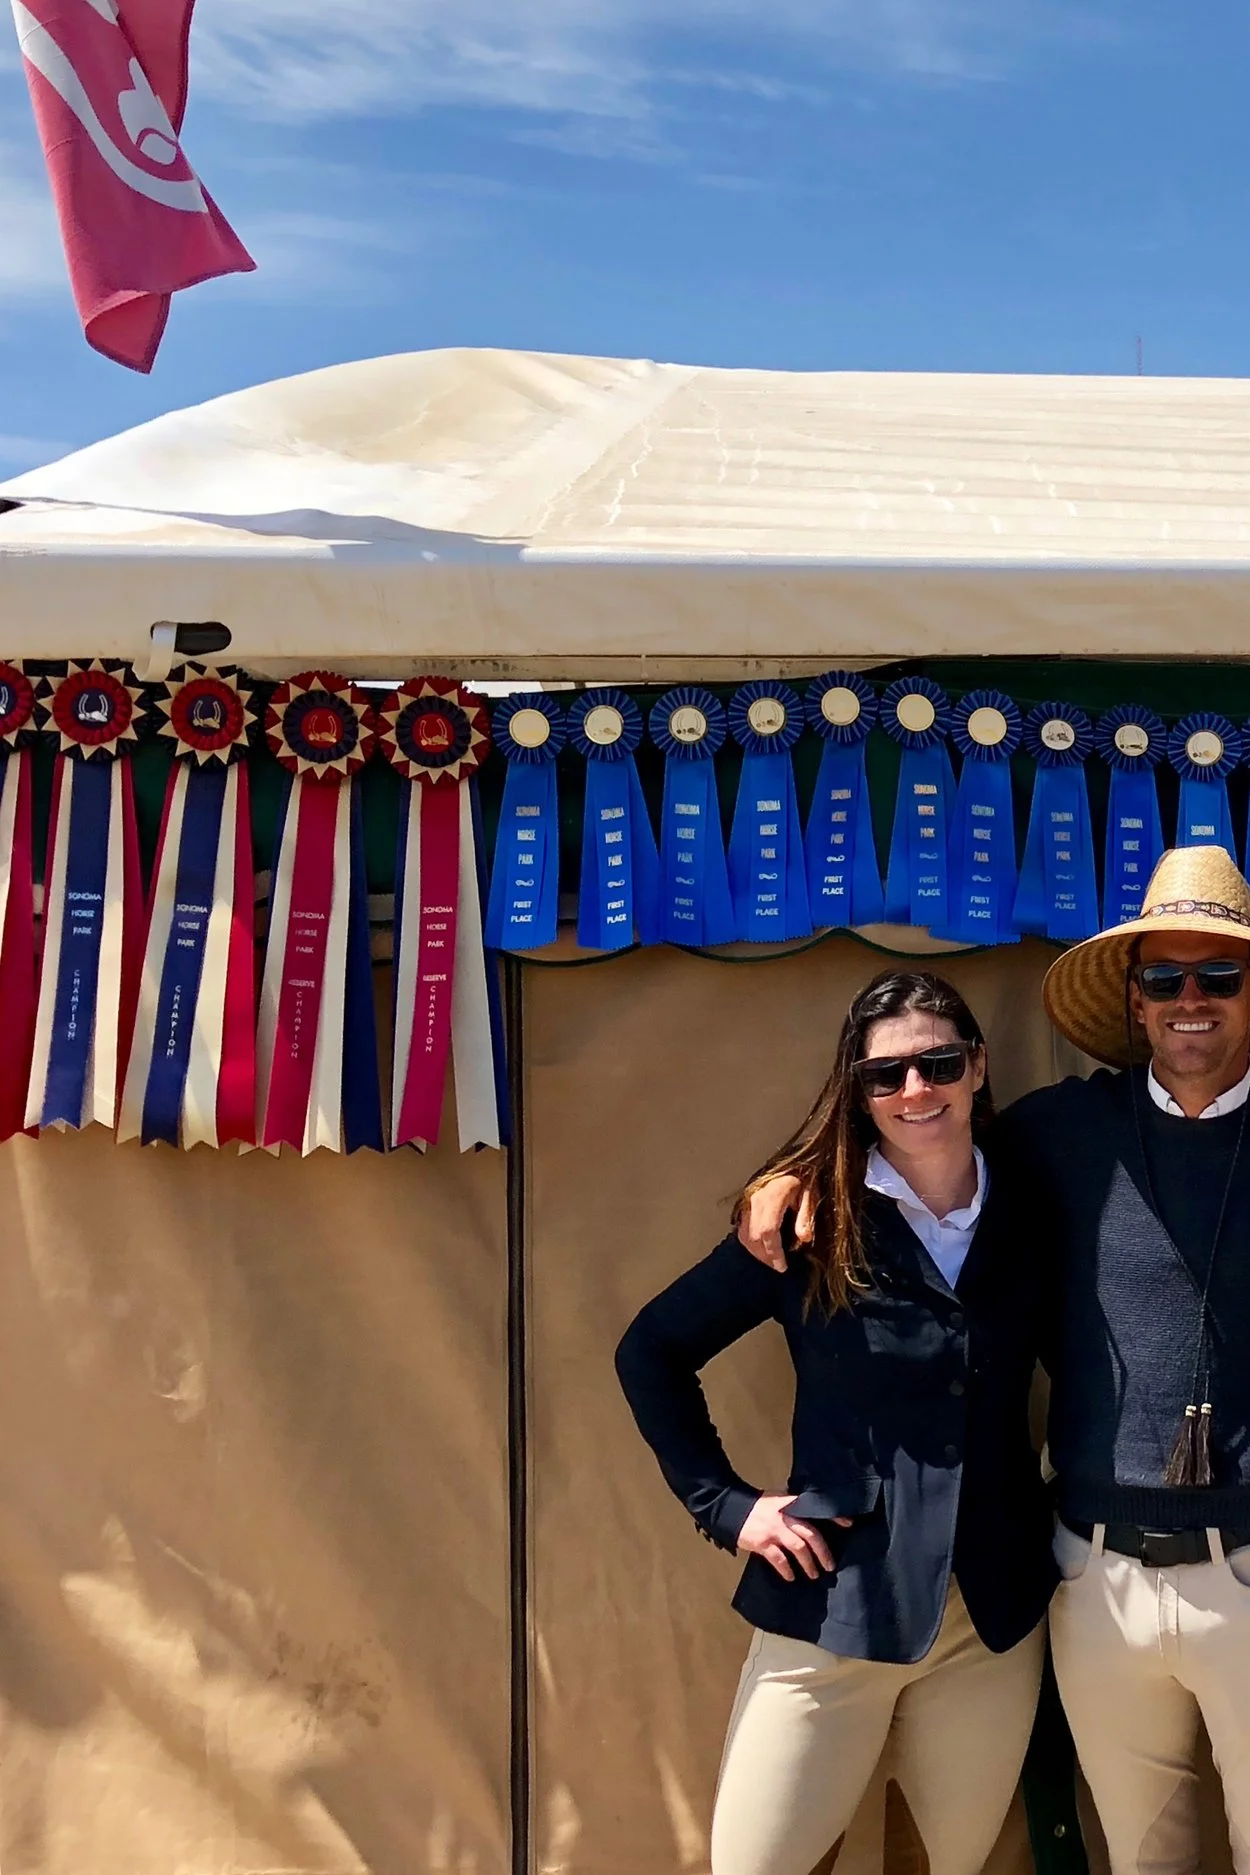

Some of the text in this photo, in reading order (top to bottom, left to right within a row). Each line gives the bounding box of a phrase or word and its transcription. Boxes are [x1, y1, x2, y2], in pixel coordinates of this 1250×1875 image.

[68, 892, 101, 900] SONOMA
[176, 904, 207, 913] SONOMA
[73, 927, 92, 935] PARK
[295, 929, 317, 937] HORSE
[177, 939, 195, 947] PARK
[68, 970, 80, 1039] CHAMPION
[167, 985, 180, 1056] CHAMPION
[426, 986, 435, 1051] CHAMPION
[291, 991, 302, 1058] CHAMPION
